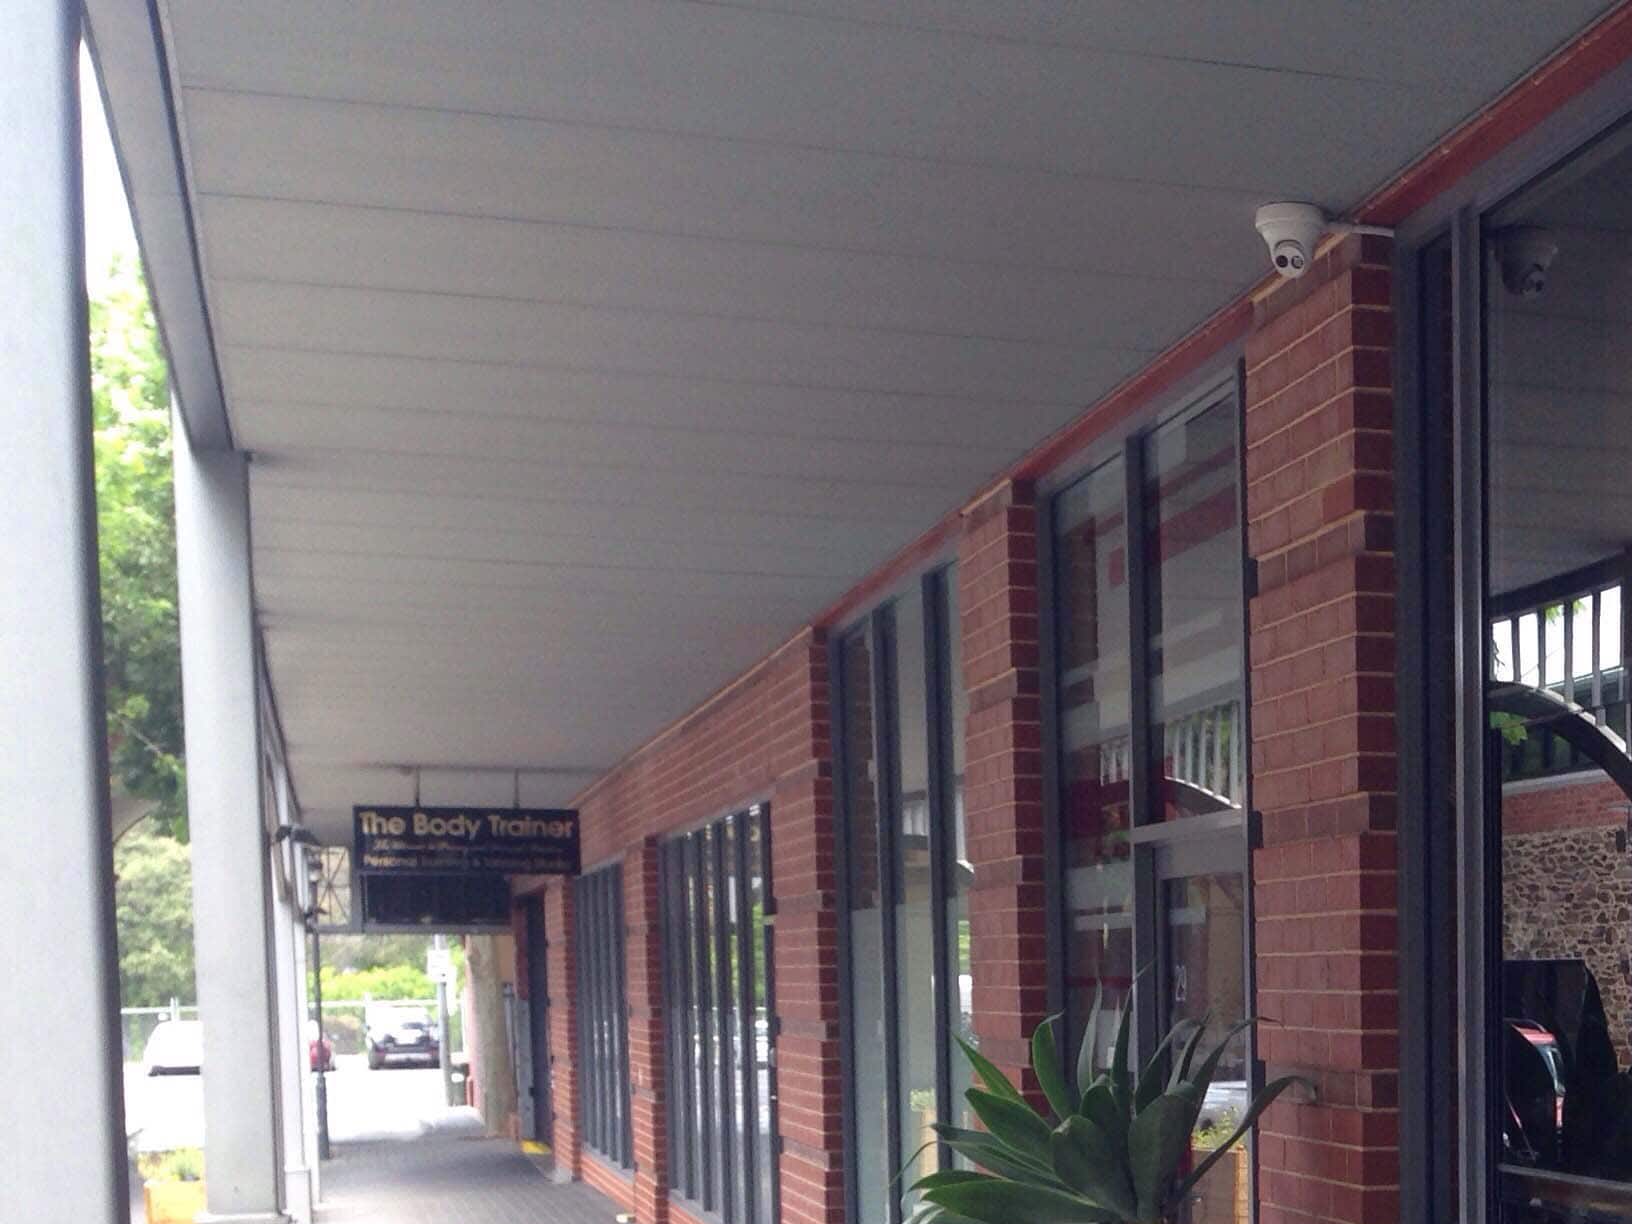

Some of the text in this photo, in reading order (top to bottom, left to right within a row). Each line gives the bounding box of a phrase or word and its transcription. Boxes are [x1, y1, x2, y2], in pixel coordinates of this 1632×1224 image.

[358, 811, 574, 840] The Body Trainer
